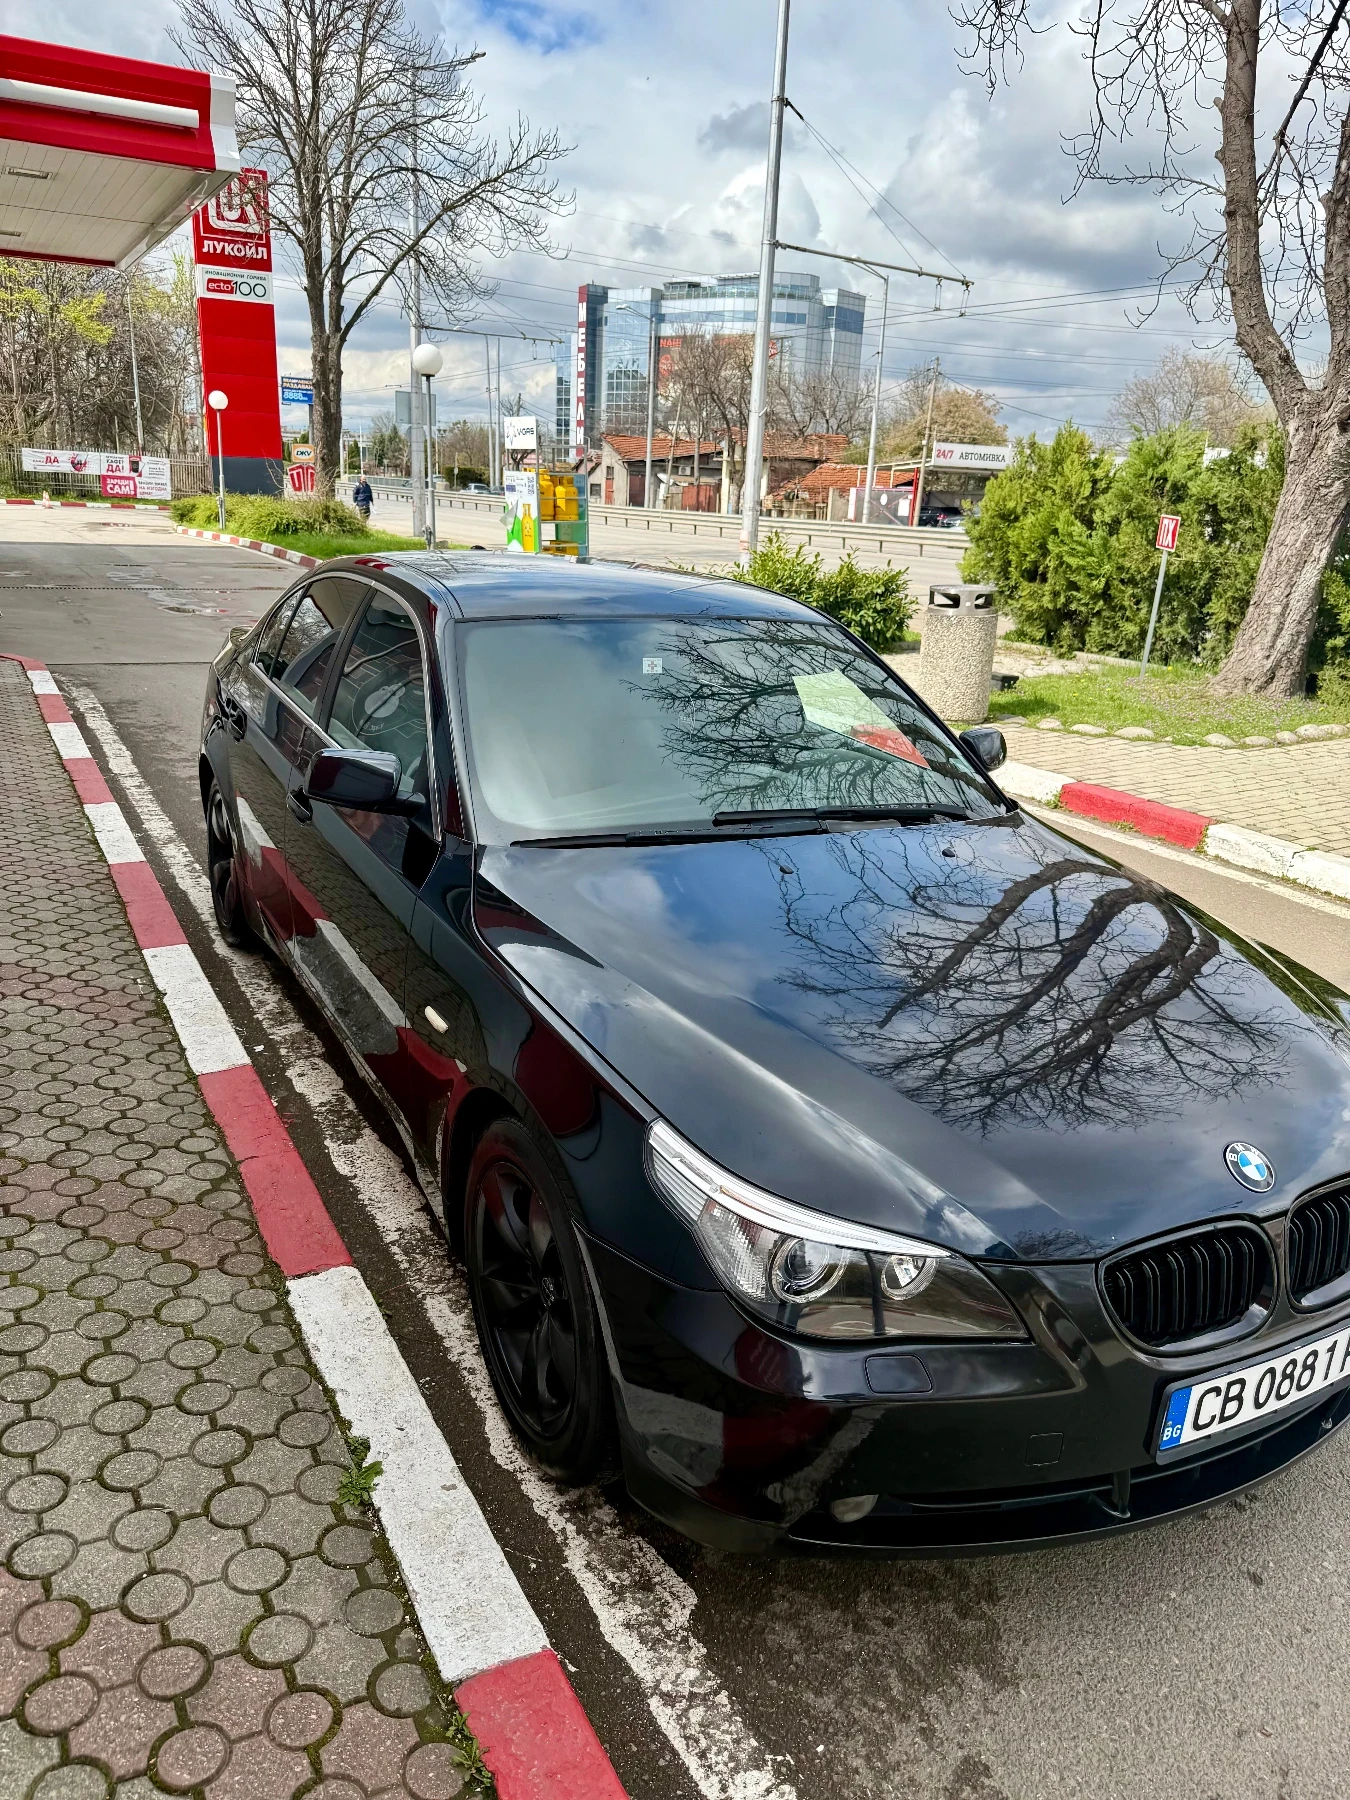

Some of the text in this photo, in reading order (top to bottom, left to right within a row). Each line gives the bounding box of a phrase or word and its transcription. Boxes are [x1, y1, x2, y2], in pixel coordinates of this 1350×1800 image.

[202, 240, 267, 260] ЛУКОЙЛ
[205, 270, 245, 279] ИНОВАЦИОННИ
[208, 280, 267, 298] ecto 100
[577, 302, 587, 444] МЕБЕЛИ
[45, 456, 59, 465] ДА
[936, 448, 1006, 463] 24/7 АВТОМИВКА
[107, 464, 124, 473] ДА!
[106, 478, 129, 486] ЗАРЕДИ
[107, 481, 135, 495] САМ!
[1158, 518, 1177, 548] ПХ
[1193, 1376, 1246, 1432] CB
[1254, 1339, 1338, 1411] 0881
[1162, 1424, 1182, 1441] BG
